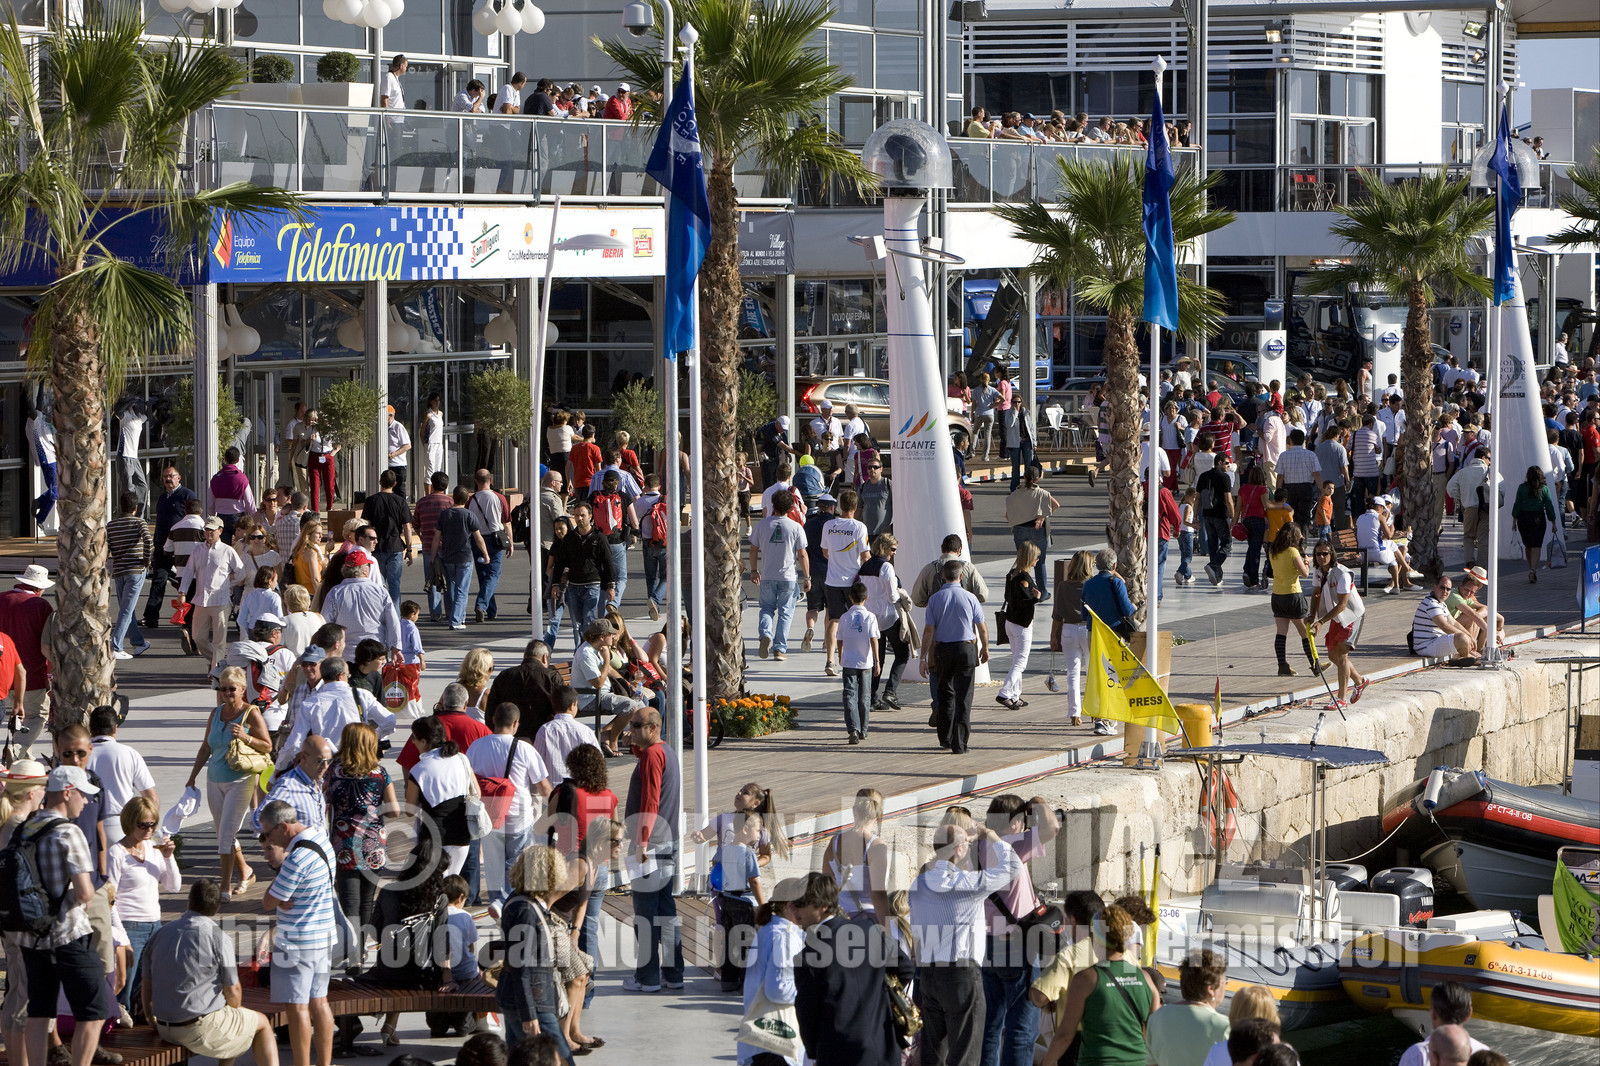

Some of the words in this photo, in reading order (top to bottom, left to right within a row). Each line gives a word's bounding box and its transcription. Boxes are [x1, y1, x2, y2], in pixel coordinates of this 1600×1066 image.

[234, 235, 255, 248] Equipo
[602, 248, 624, 258] IBERIA
[892, 440, 937, 450] ALICANTE
[1129, 695, 1164, 708] PRESS
